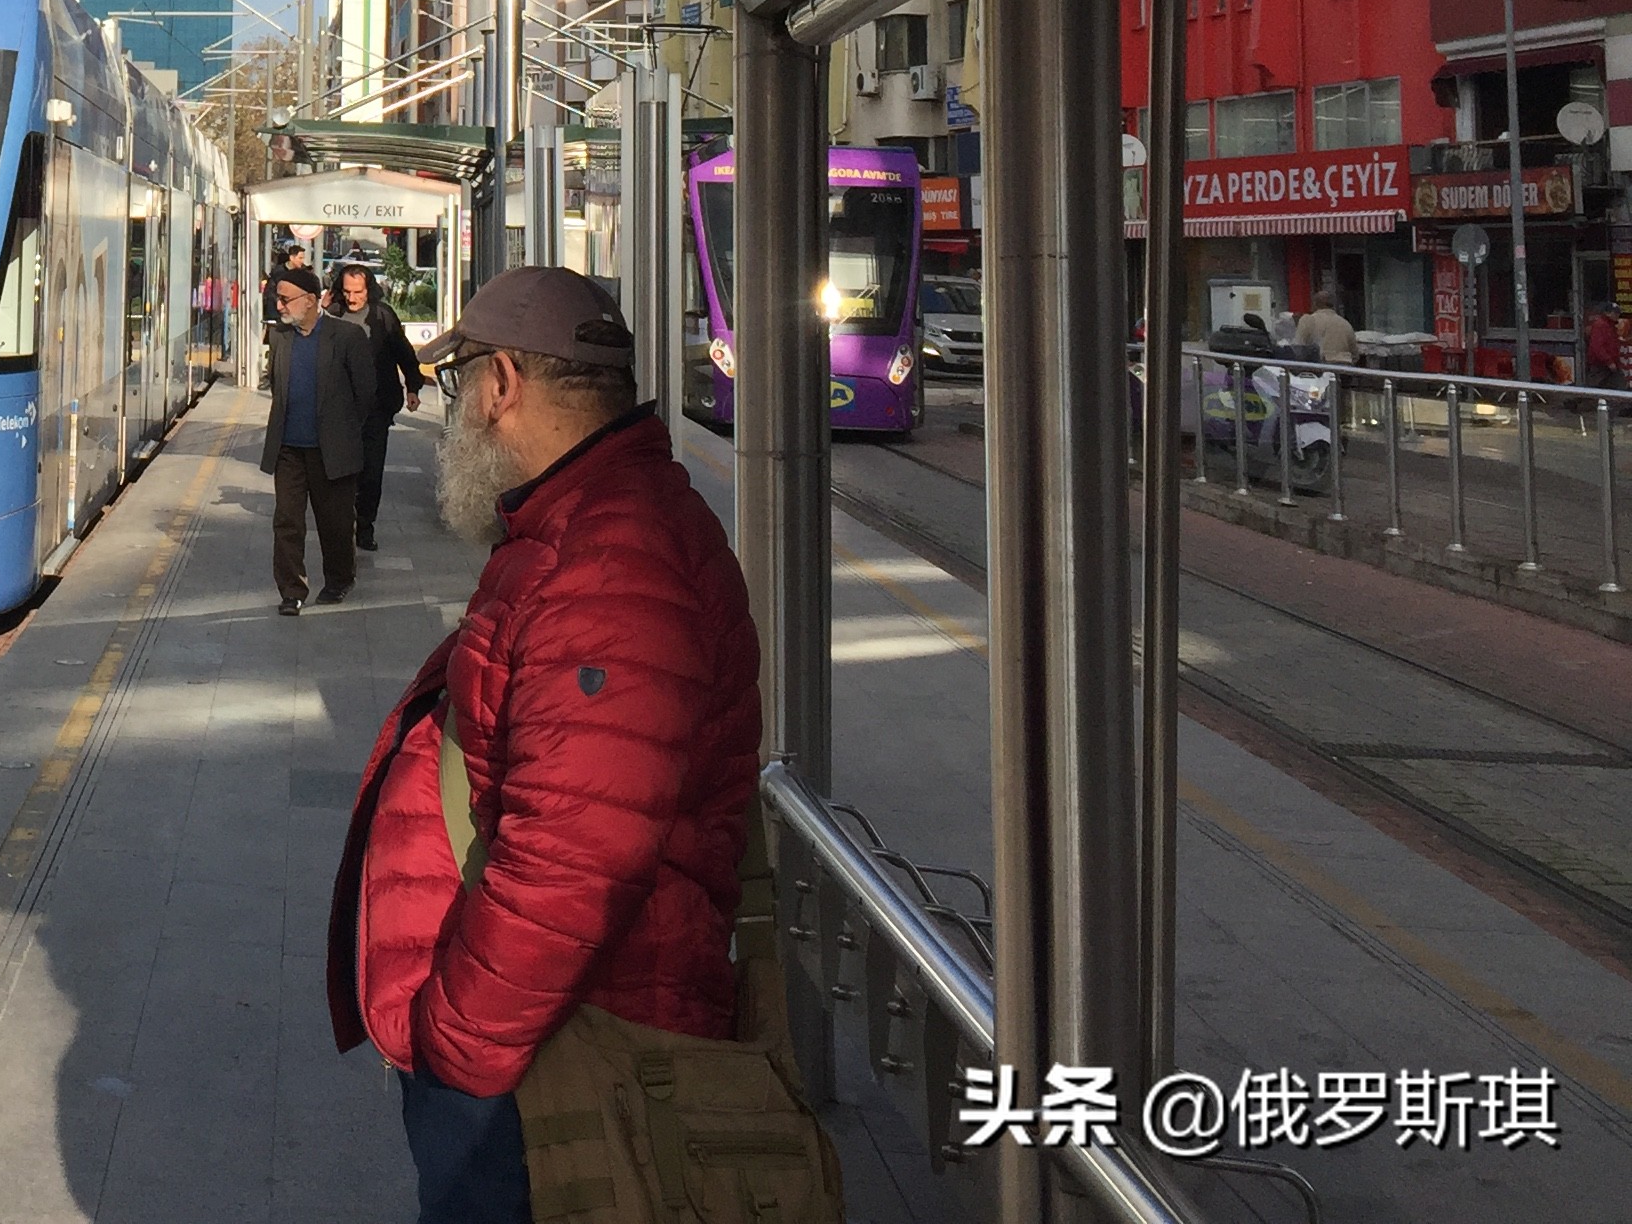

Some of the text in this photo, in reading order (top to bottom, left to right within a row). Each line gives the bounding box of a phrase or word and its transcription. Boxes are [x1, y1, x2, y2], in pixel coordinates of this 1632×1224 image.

[1184, 175, 1224, 205] YZA
[1492, 179, 1539, 208] DÖER
[323, 204, 359, 219] ÇIKIŞ
[375, 205, 405, 217] EXIT
